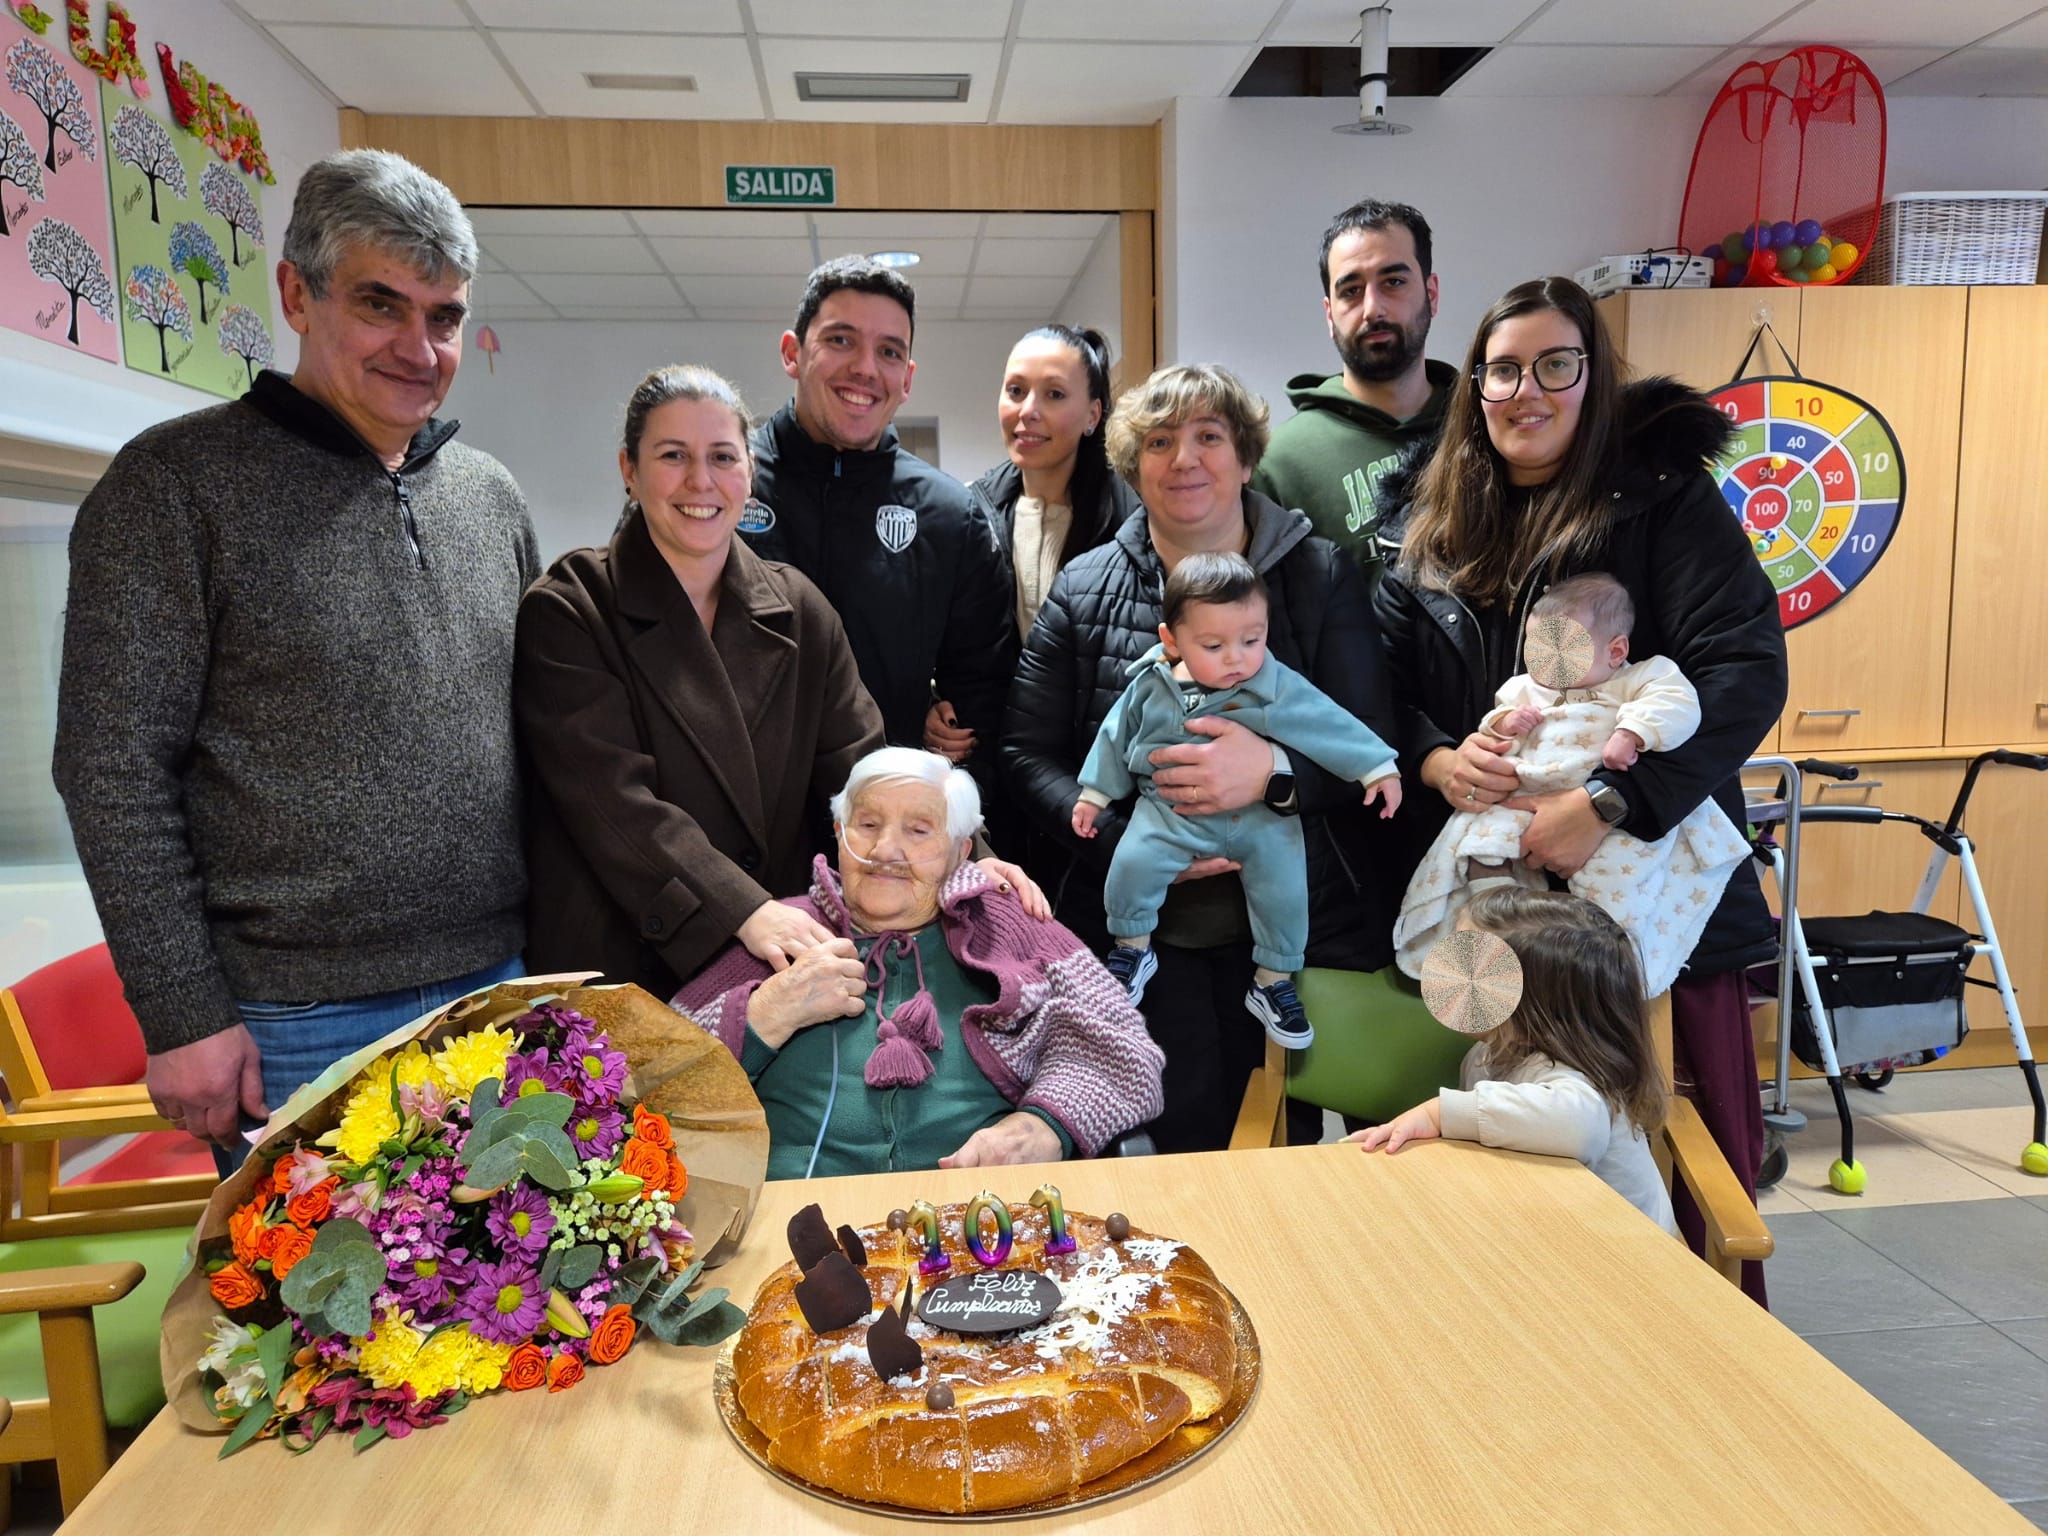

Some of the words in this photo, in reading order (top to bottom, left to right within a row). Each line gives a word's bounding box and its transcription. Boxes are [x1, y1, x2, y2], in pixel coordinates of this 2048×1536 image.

[735, 171, 825, 196] SALIDA
[1795, 397, 1823, 417] 10
[1786, 435, 1806, 450] 40
[1862, 452, 1890, 474] 10
[1758, 465, 1777, 480] 90
[1824, 470, 1844, 486] 50
[1753, 501, 1779, 516] 100
[1795, 499, 1812, 513] 70
[1820, 525, 1839, 541] 20
[1850, 533, 1876, 554] 10
[1777, 566, 1794, 579] 50
[1788, 591, 1812, 611] 10
[904, 1184, 1077, 1275] 101
[968, 1272, 1037, 1297] Feliz
